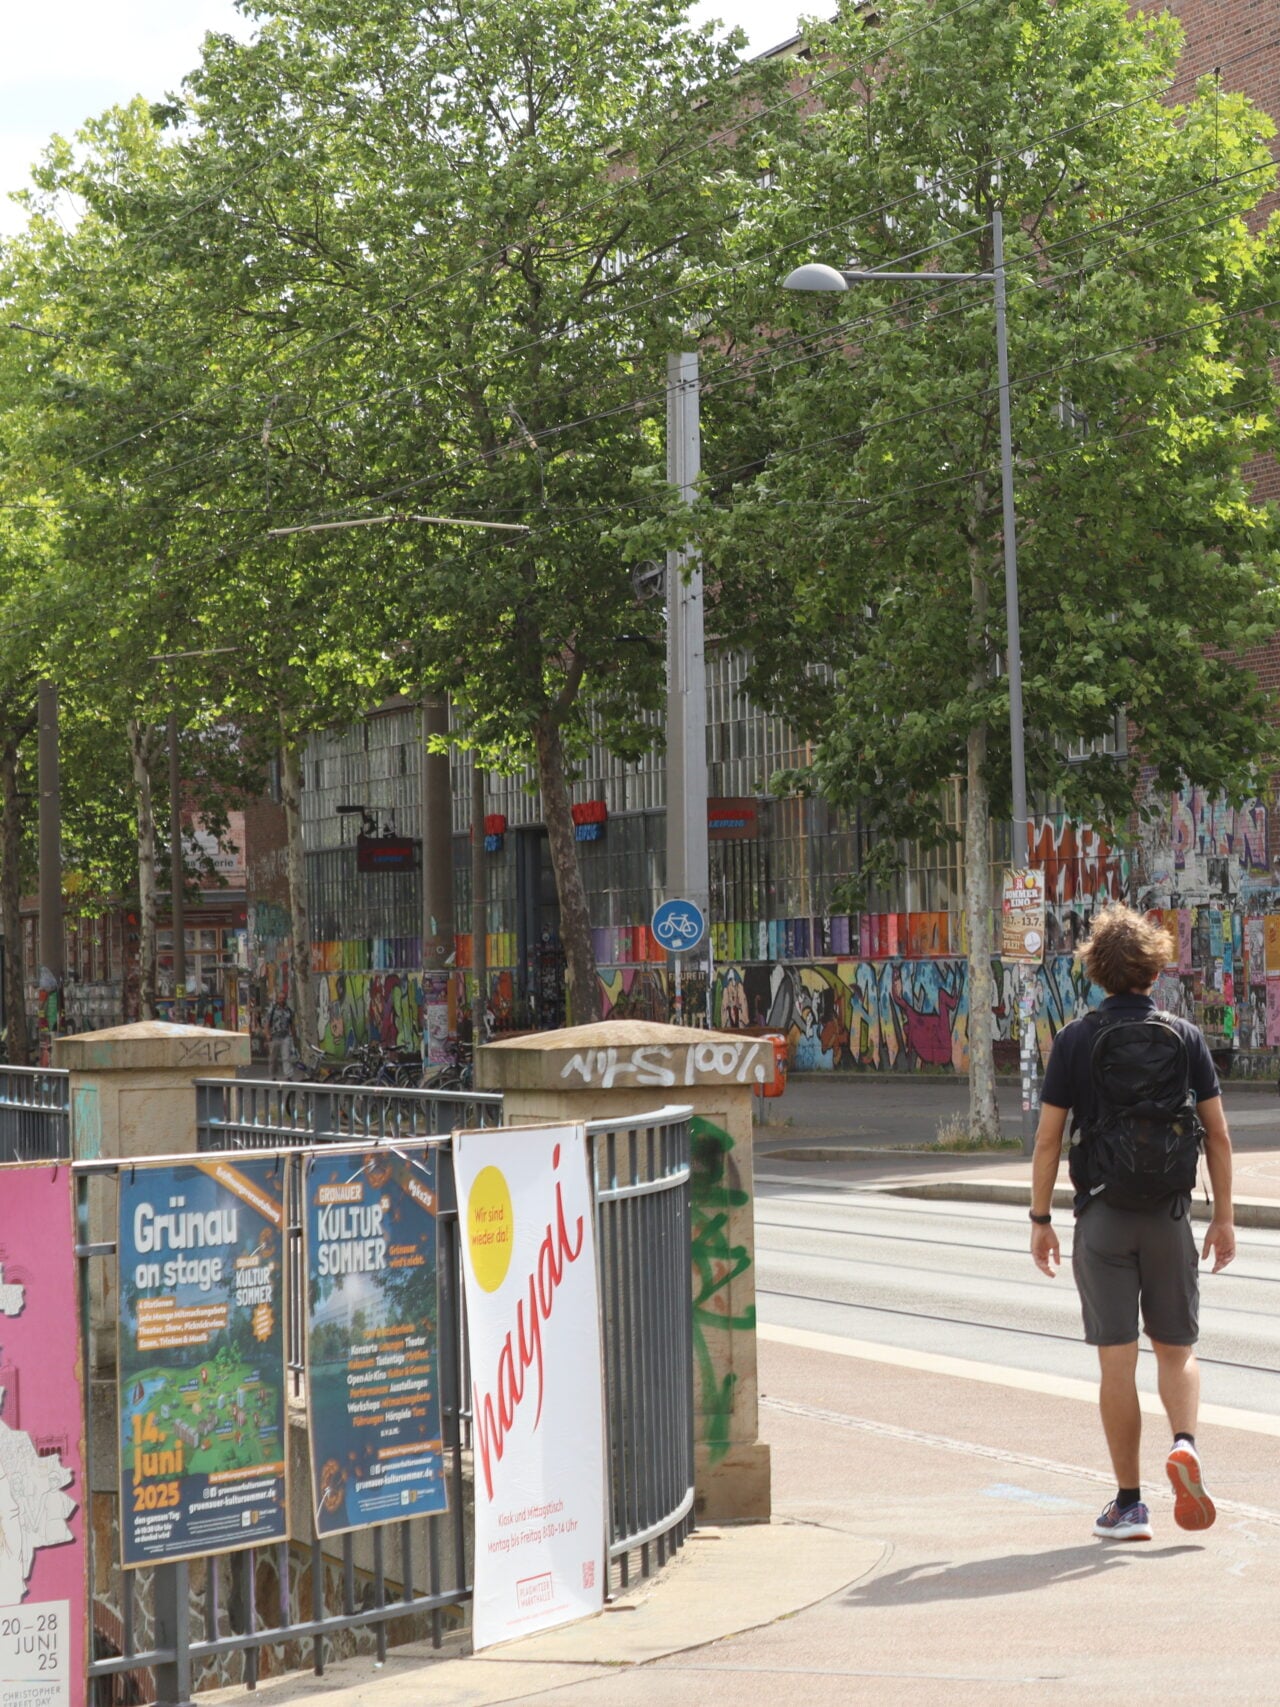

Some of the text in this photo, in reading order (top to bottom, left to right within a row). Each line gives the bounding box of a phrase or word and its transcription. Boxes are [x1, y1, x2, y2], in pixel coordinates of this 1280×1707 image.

[318, 1203, 384, 1242] KULTUR
[487, 1203, 504, 1221] sind
[134, 1195, 239, 1254] Grünau
[472, 1228, 495, 1247] wieder
[318, 1237, 387, 1276] SOMMER
[136, 1252, 223, 1292] on stage
[235, 1267, 271, 1290] KULTUR
[235, 1286, 273, 1307] SOMMER
[131, 1411, 167, 1446] 14.
[132, 1481, 182, 1513] 2025
[14, 1632, 57, 1656] JUNI
[37, 1652, 58, 1672] 25
[3, 1686, 61, 1702] CHRISTOPHER
